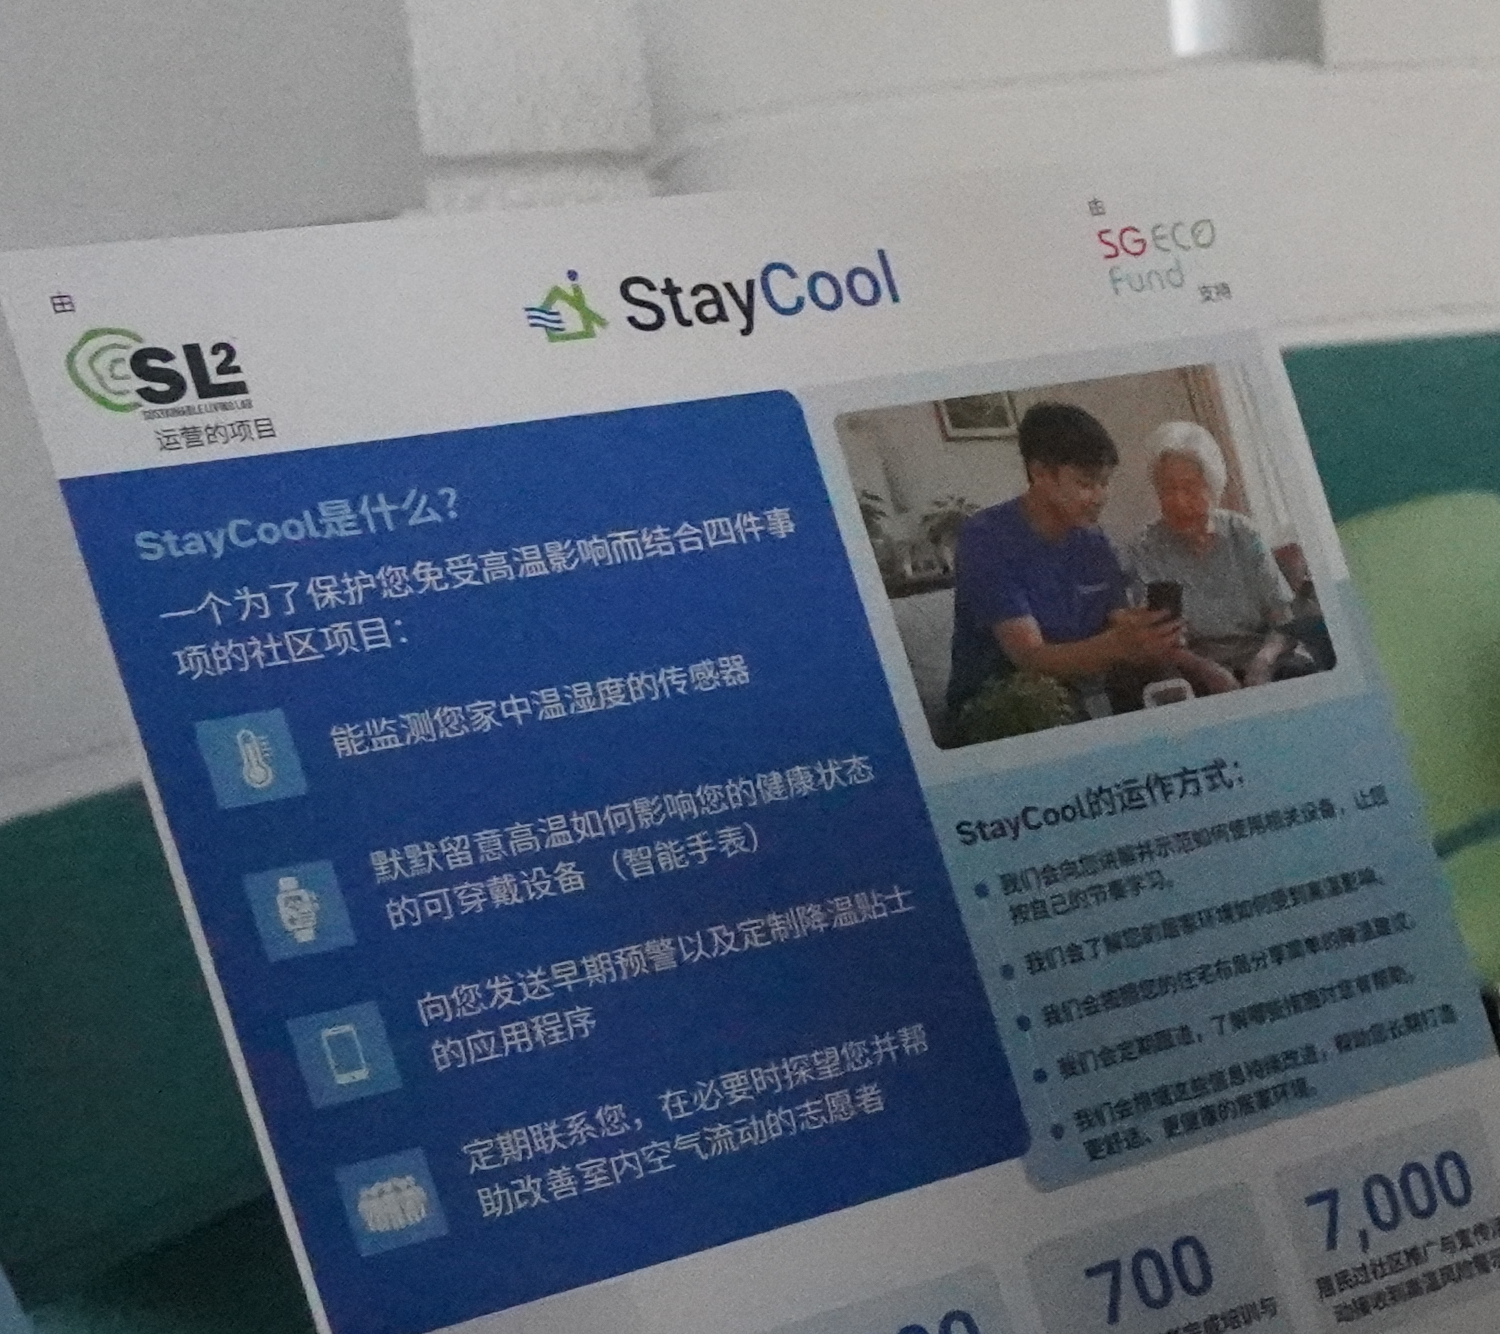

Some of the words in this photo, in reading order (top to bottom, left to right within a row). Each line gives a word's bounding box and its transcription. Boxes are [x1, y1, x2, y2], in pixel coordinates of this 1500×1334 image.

[51, 291, 76, 315] 由
[618, 247, 901, 337] StayCool
[1108, 261, 1187, 297] Fund
[154, 417, 278, 452] 运营的项目
[160, 506, 797, 624] 一个为了保护您免受高温影响而结合四件事
[174, 615, 411, 681] 项的社区项目：
[330, 653, 752, 758] 能监测您家中温湿度的传感器
[370, 754, 874, 885] 默默留意高温如何影响您的健康状态
[417, 885, 915, 1029] 向您发送早期预警以及定制降温贴士
[431, 1004, 598, 1072] 的应用程序
[478, 1083, 886, 1222] 助改善室内空气流动的志愿者
[1306, 1149, 1473, 1254] 7,000
[1085, 1234, 1214, 1325] 700
